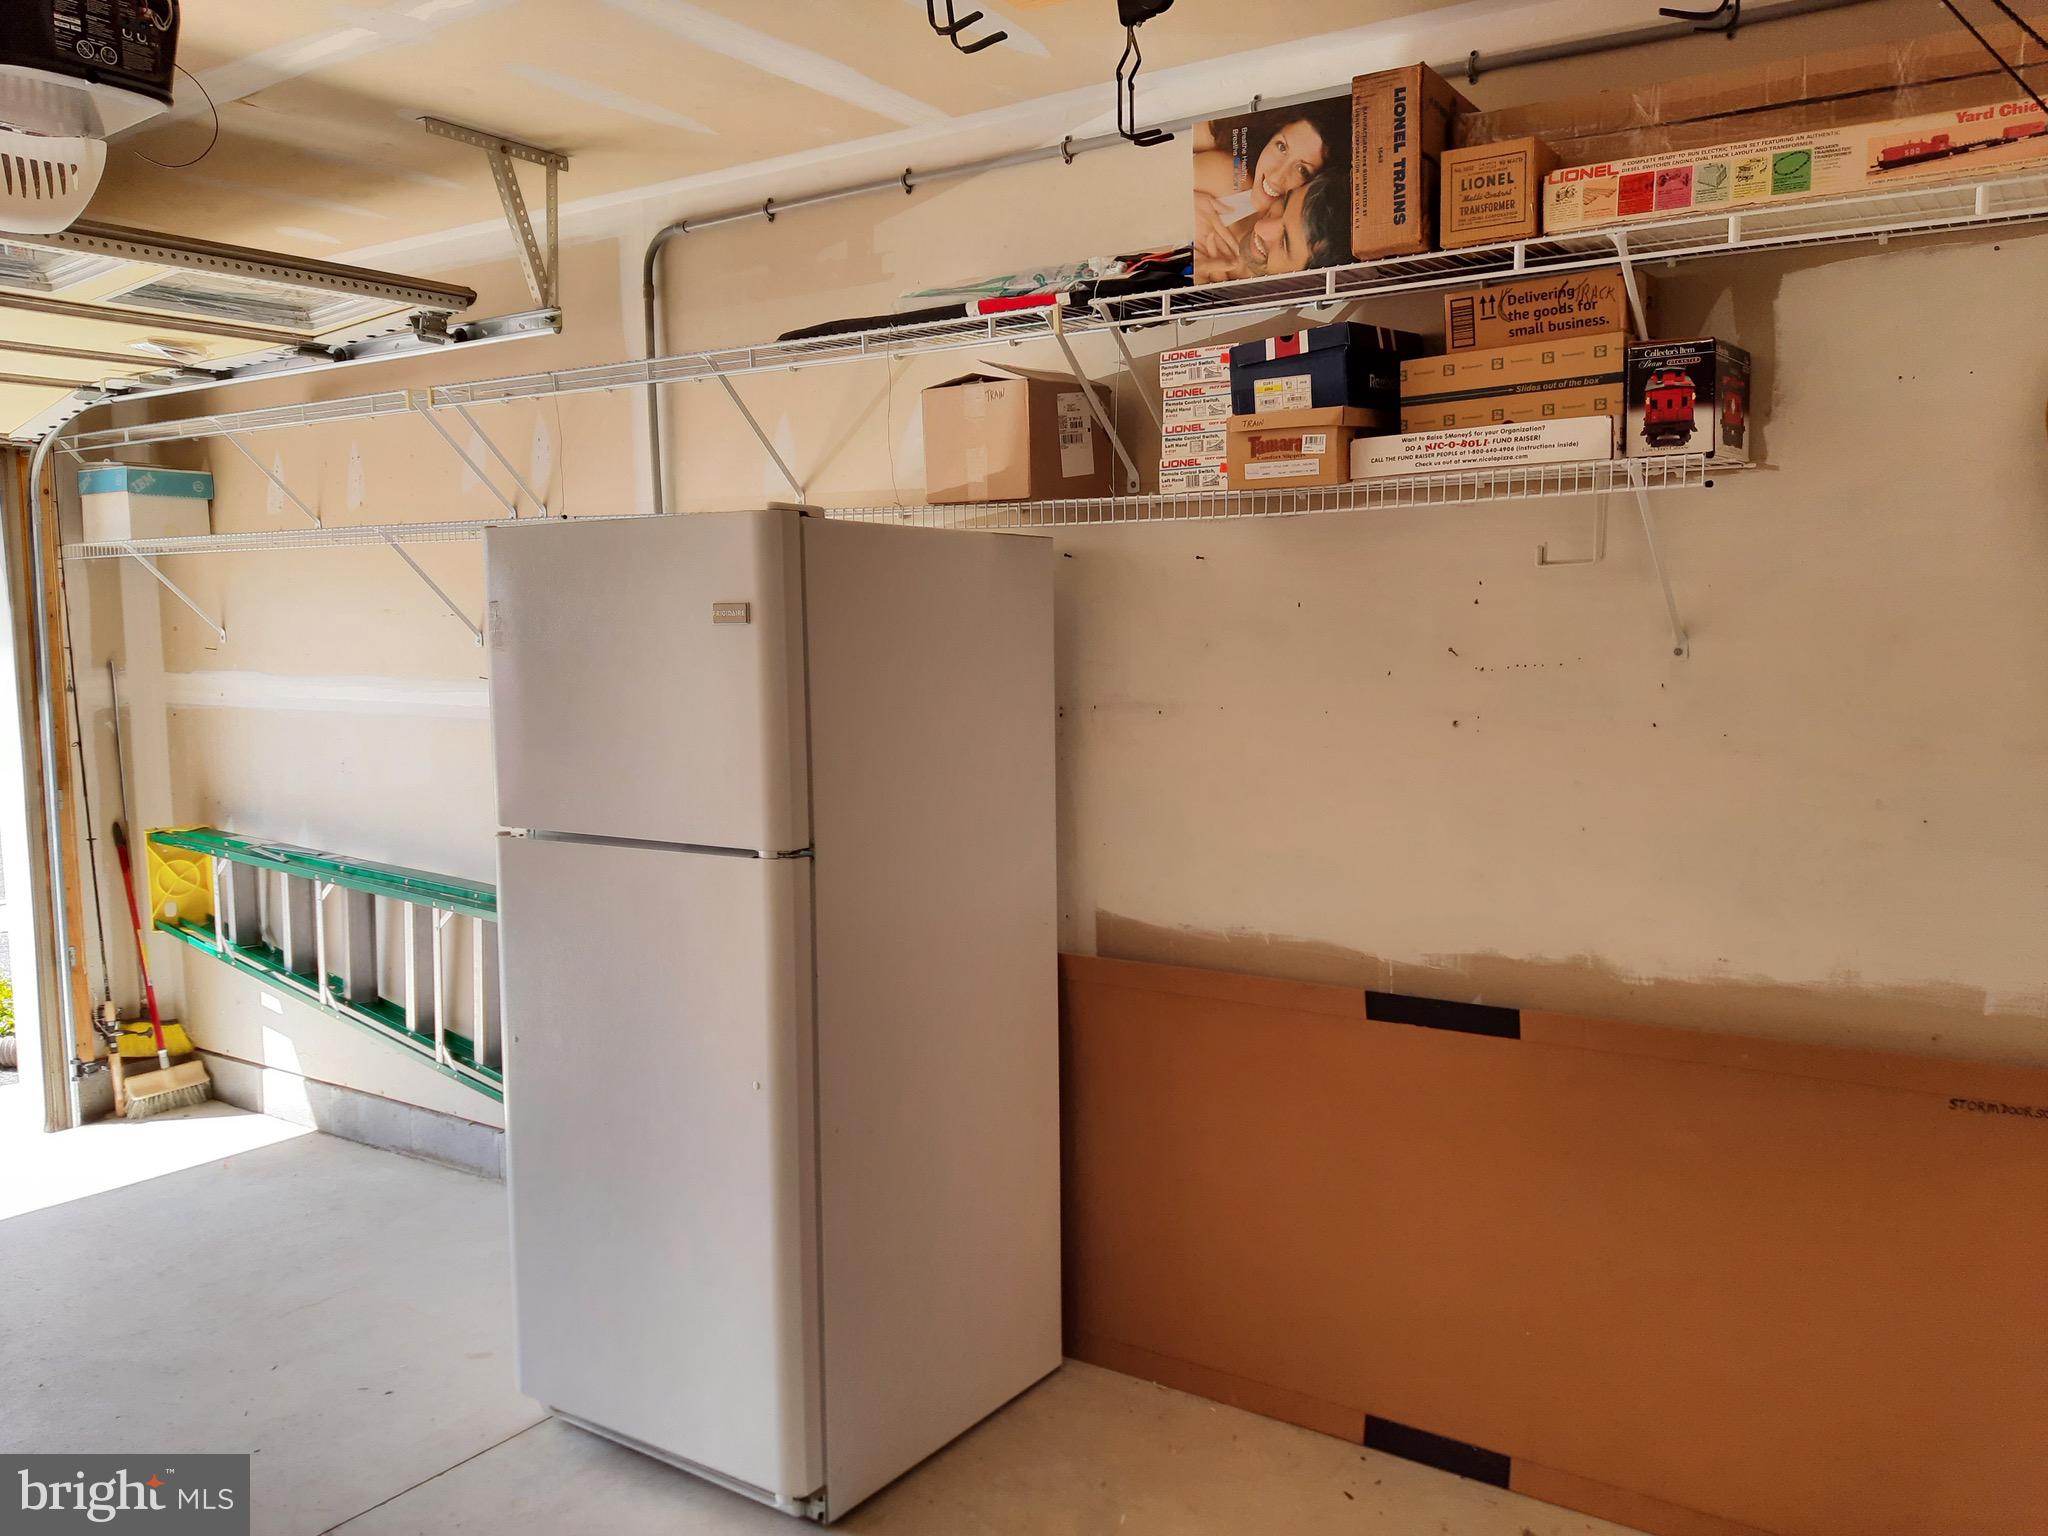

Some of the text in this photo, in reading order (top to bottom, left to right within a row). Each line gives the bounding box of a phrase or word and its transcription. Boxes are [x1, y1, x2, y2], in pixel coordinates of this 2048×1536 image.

[1956, 99, 2047, 124] Yard Chie
[1393, 86, 1407, 226] LIONEL TRAINS
[1627, 157, 1656, 166] COMPLETE
[1701, 146, 1727, 155] ELECTRIC
[1730, 143, 1747, 151] TRAIN
[1762, 136, 1794, 146] FEATURING
[1806, 130, 1840, 140] AUTHENTIC
[1548, 165, 1619, 185] LIONEL
[1642, 161, 1671, 170] SWITCHER
[1711, 152, 1729, 160] TRACK
[1730, 150, 1754, 158] LAYOUT
[1461, 172, 1514, 191] LIONEL
[1460, 200, 1516, 216] TRANSFORMER
[1508, 287, 1575, 306] Delivering
[1575, 278, 1616, 302] TRACK
[1508, 300, 1598, 321] the goods for
[1509, 316, 1610, 338] small business.
[1162, 350, 1202, 362] LIONEL
[1644, 348, 1678, 358] Collector's
[1515, 376, 1599, 393] Slides out of the box
[984, 388, 1005, 402] TRAIN
[1166, 388, 1206, 398] LIONEL
[1166, 424, 1205, 434] LIONEL
[1242, 419, 1264, 428] TRAIN
[1444, 430, 1472, 439] $Money$
[1500, 425, 1546, 435] Organization?
[1516, 443, 1555, 452] (instructions
[1162, 458, 1202, 468] LIONEL
[1948, 1098, 2000, 1114] STORM
